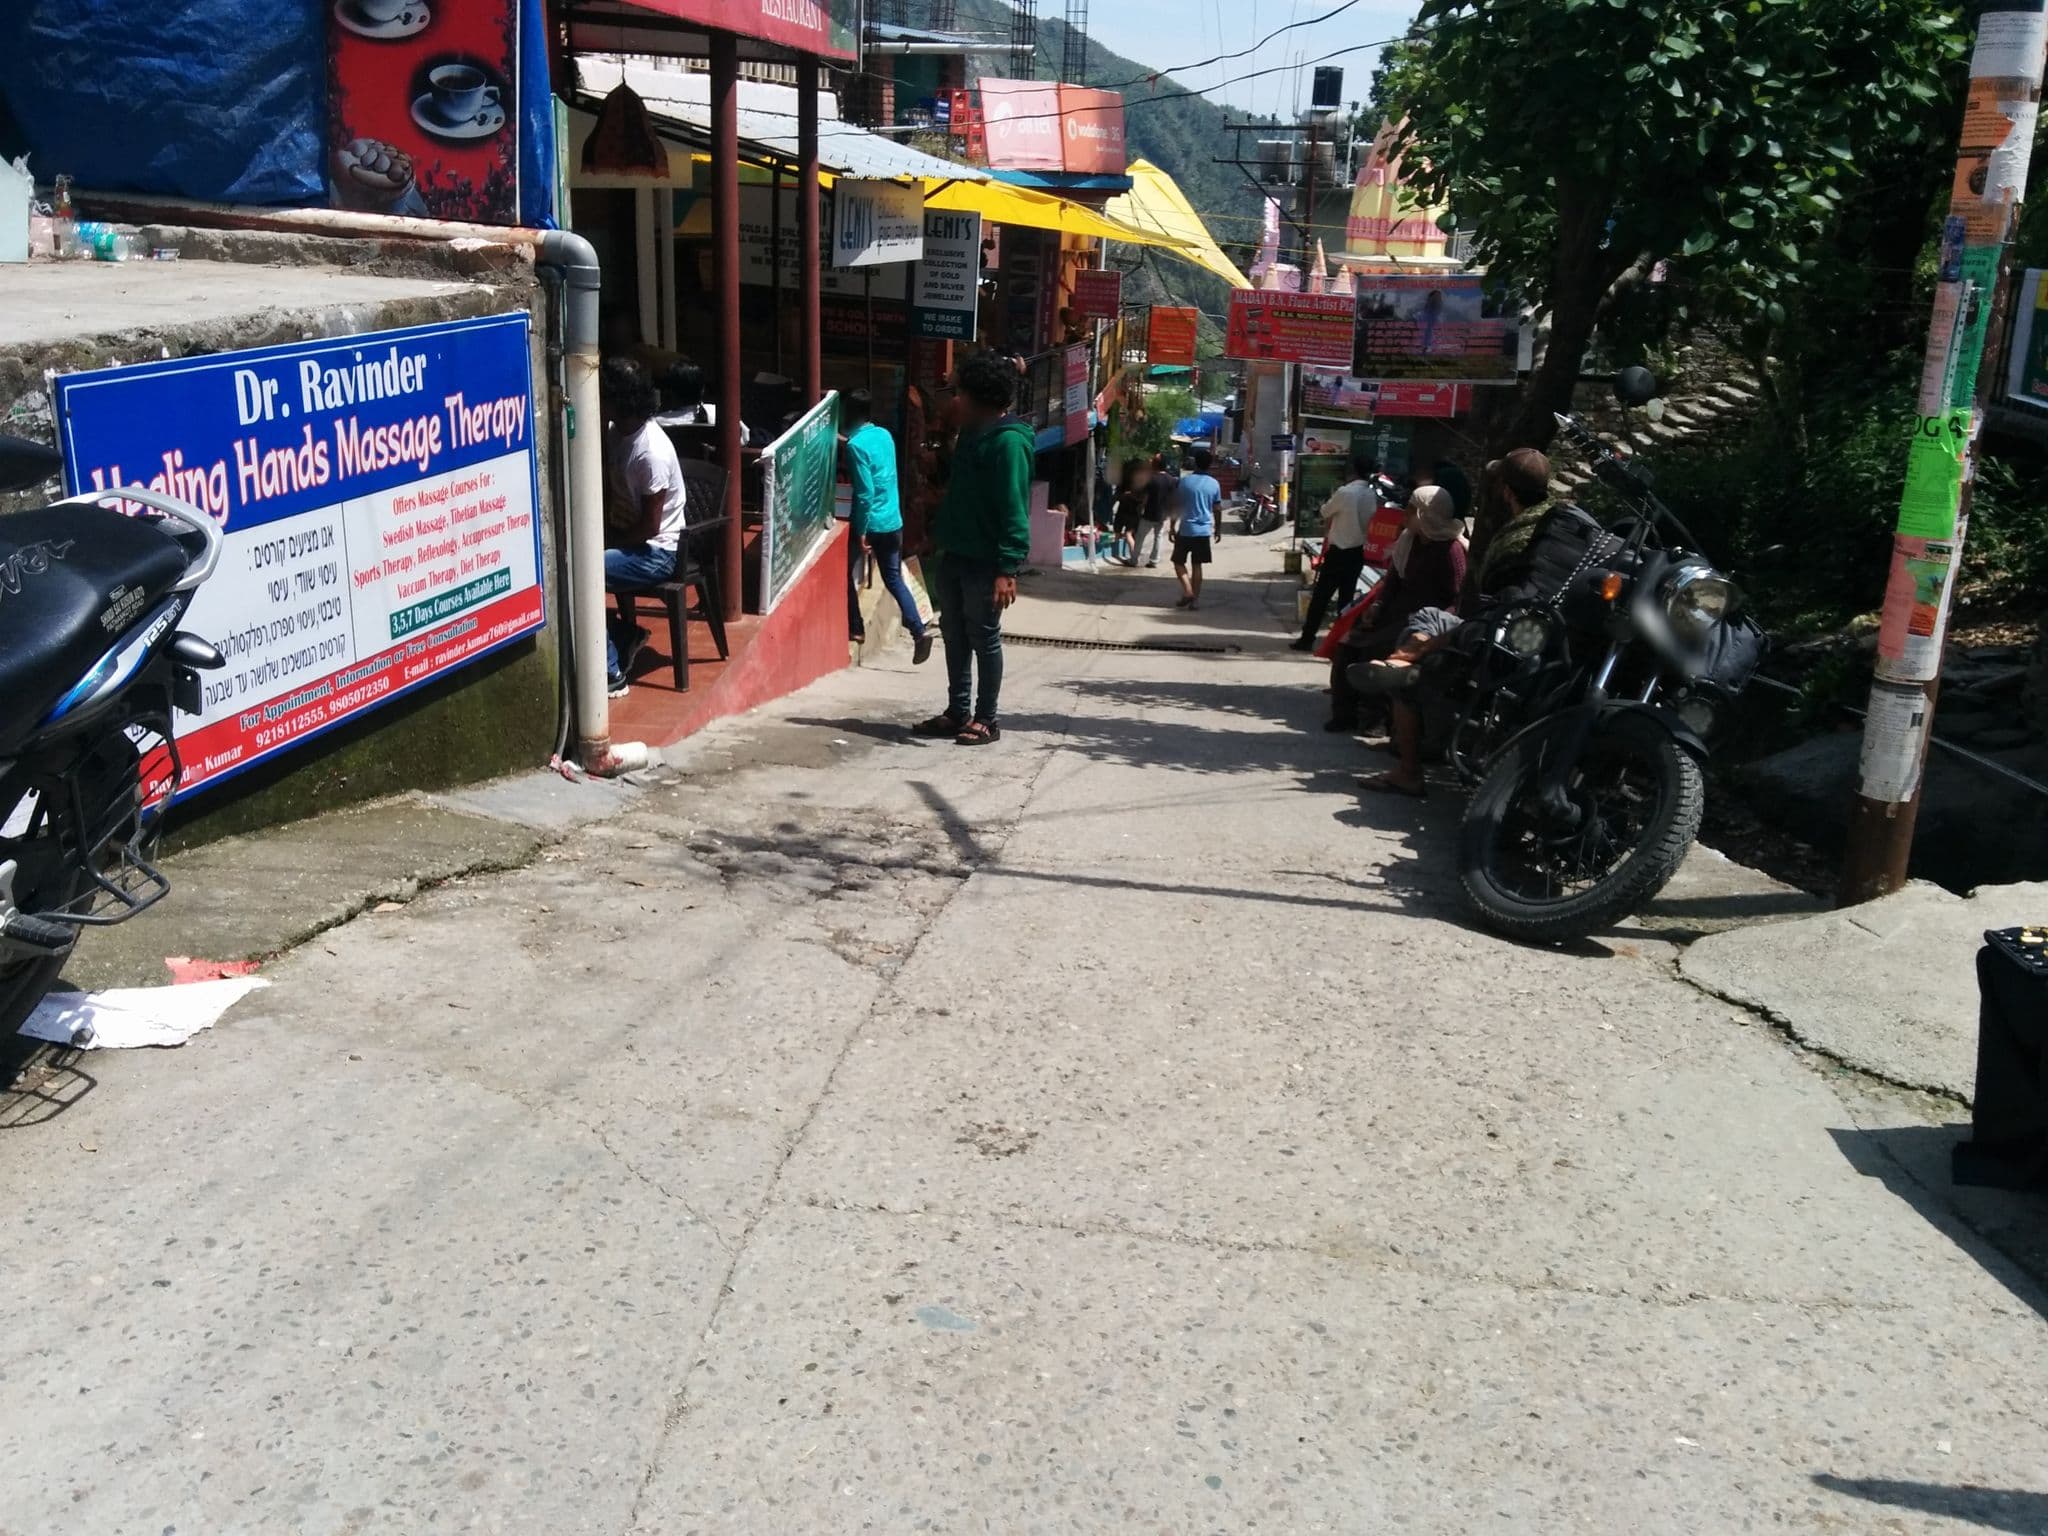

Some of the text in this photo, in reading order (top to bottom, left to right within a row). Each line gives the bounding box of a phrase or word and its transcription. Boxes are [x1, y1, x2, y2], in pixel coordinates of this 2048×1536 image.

[923, 213, 972, 241] LENI'S
[923, 259, 968, 269] COLLECTION
[940, 271, 960, 280] GOLD
[923, 281, 966, 291] AND SILVER
[922, 323, 964, 335] TO ORDER
[923, 313, 962, 324] WE MAKE
[234, 346, 428, 426] Dr. Ravinder
[91, 391, 526, 528] Healing Hands Massage Therapy
[392, 494, 417, 516] Offers
[417, 486, 449, 507] Massage
[450, 477, 478, 498] Courses
[479, 471, 490, 488] For
[382, 493, 507, 549] Swedish Massage, Tibetian Massage
[288, 529, 319, 559] מציעים
[320, 524, 335, 549] אנו
[353, 511, 531, 592] Sports Therapy, Reflexology, Accupressure Therapy
[253, 536, 286, 569] קורסים
[317, 561, 338, 586] עיסוי
[397, 548, 501, 600] Vaccum Therapy, Diet Therapy
[267, 577, 289, 604] עיסוי
[391, 571, 510, 635] 3,5,7 Days Courses Available Here
[143, 616, 169, 648] 125
[318, 633, 346, 660] קורסים
[234, 672, 250, 695] עד
[239, 616, 478, 733] For Appointment, Information or Free Consultation
[250, 656, 280, 691] שלושה
[205, 678, 234, 708] שבעה
[204, 744, 244, 773] Kumar
[255, 705, 328, 748] 9218112555,
[328, 675, 391, 716] 9805072350
[403, 657, 429, 681] E-mail
